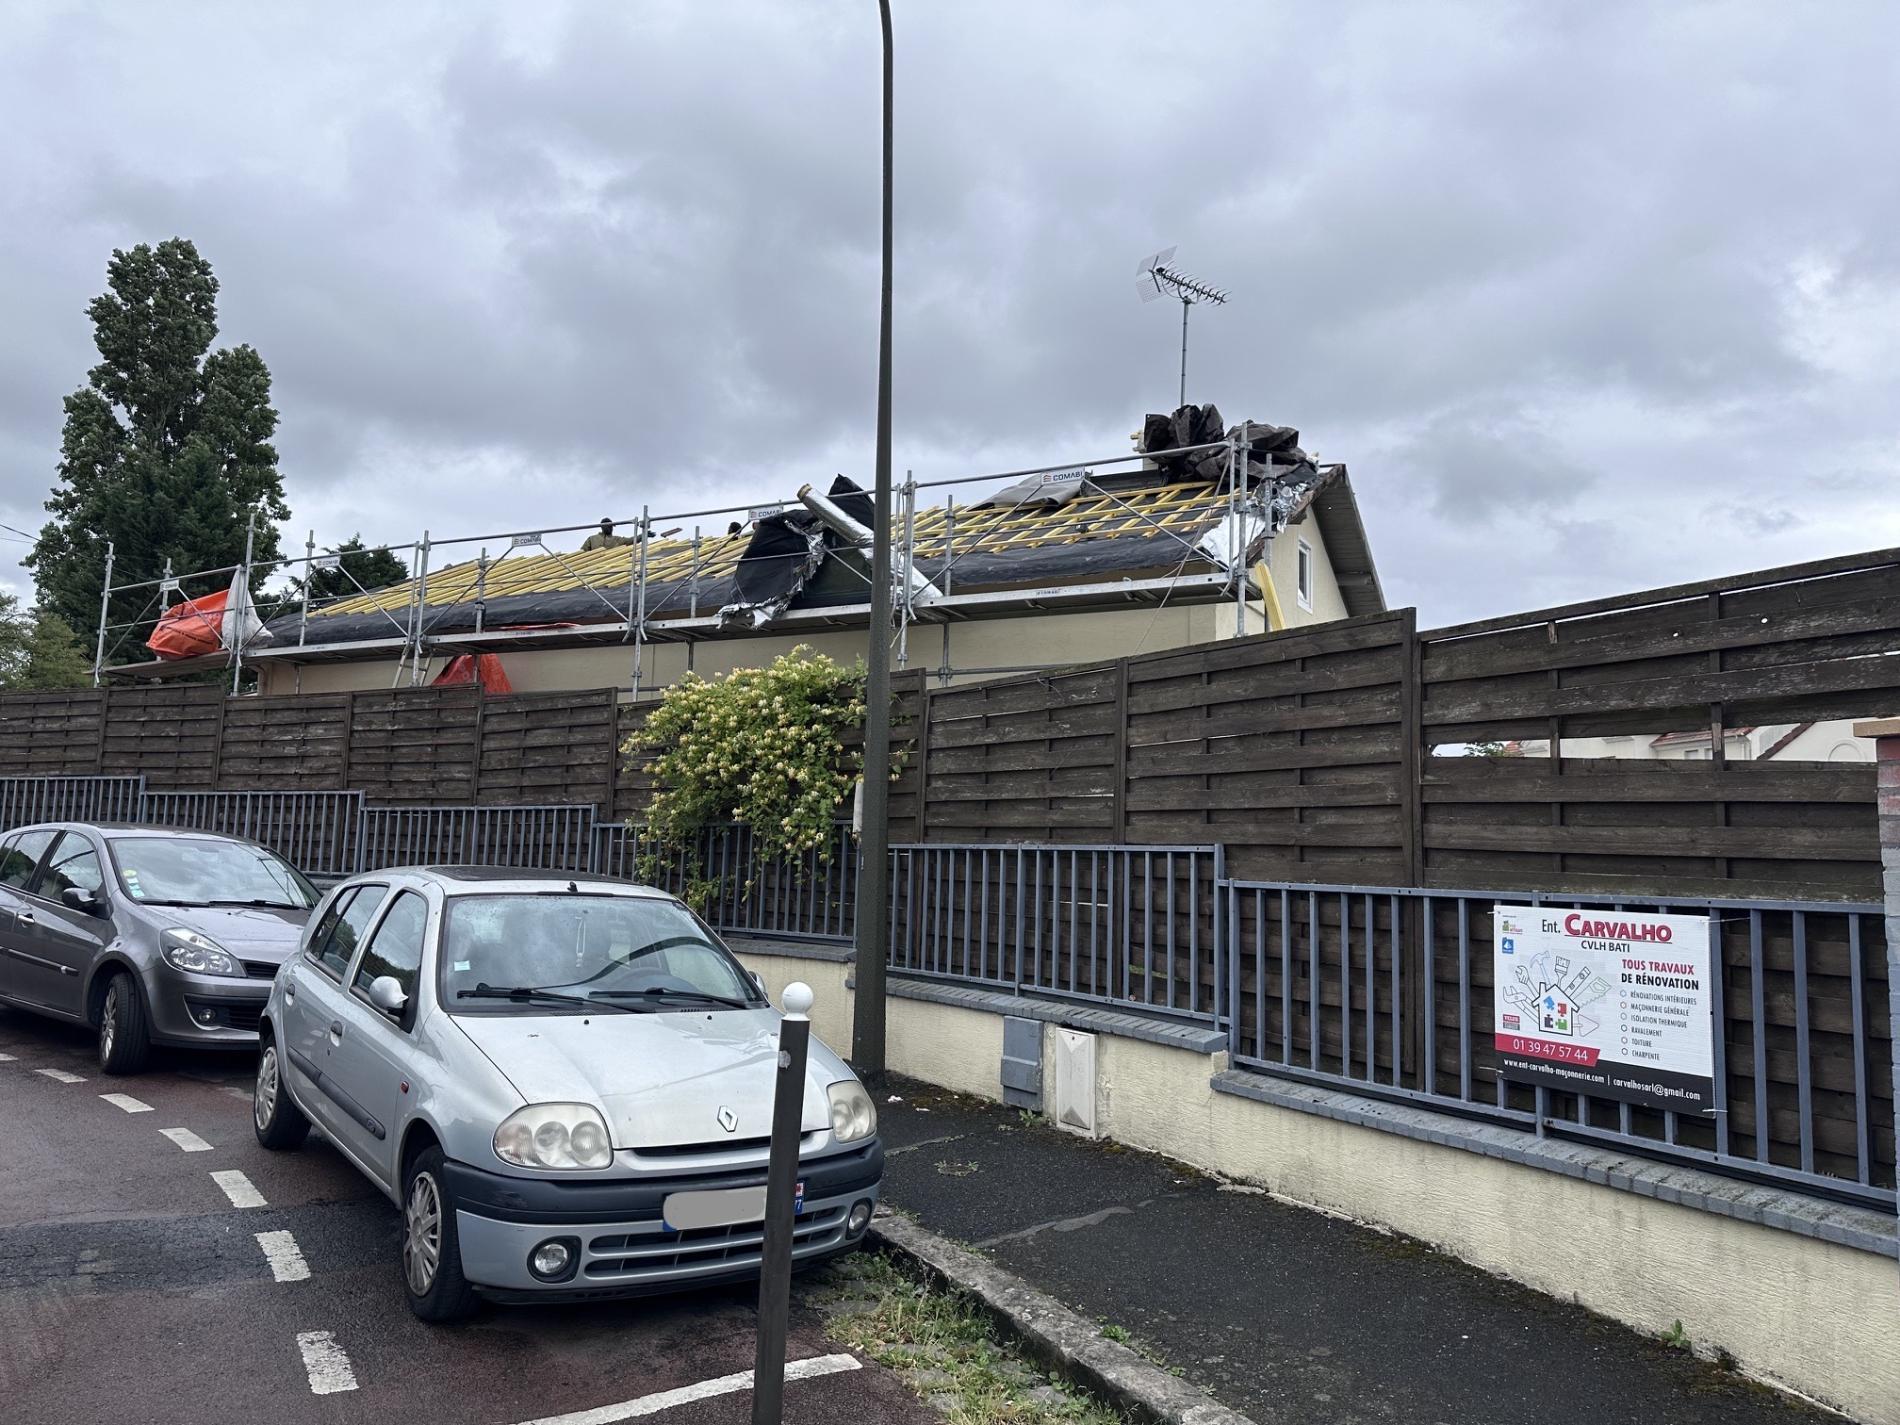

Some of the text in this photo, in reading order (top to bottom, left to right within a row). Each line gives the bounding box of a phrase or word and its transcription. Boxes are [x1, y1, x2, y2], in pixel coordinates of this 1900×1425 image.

[1053, 471, 1083, 481] COMABI
[1541, 919, 1561, 934] Ent.
[1564, 913, 1673, 942] CARVALHO
[1581, 940, 1630, 953] CVLH BATI
[1622, 959, 1695, 975] TOUS TRAVAUX
[1621, 972, 1699, 991] DE RÉNOVATION
[1630, 990, 1664, 1002] RÉNOVATIONS
[1631, 1003, 1689, 1017] MAÇONNERIE GÉNÉRALE
[1631, 1014, 1687, 1029] ISOLATION THERMIQUE
[1631, 1026, 1662, 1037] RAVALEMENT
[1513, 1038, 1588, 1061] 01 39 47 57 44
[1631, 1038, 1652, 1047] TOITURE
[1632, 1050, 1660, 1061] CHARPENTE
[1613, 1078, 1701, 1101] carvalhosarl@gmail.com
